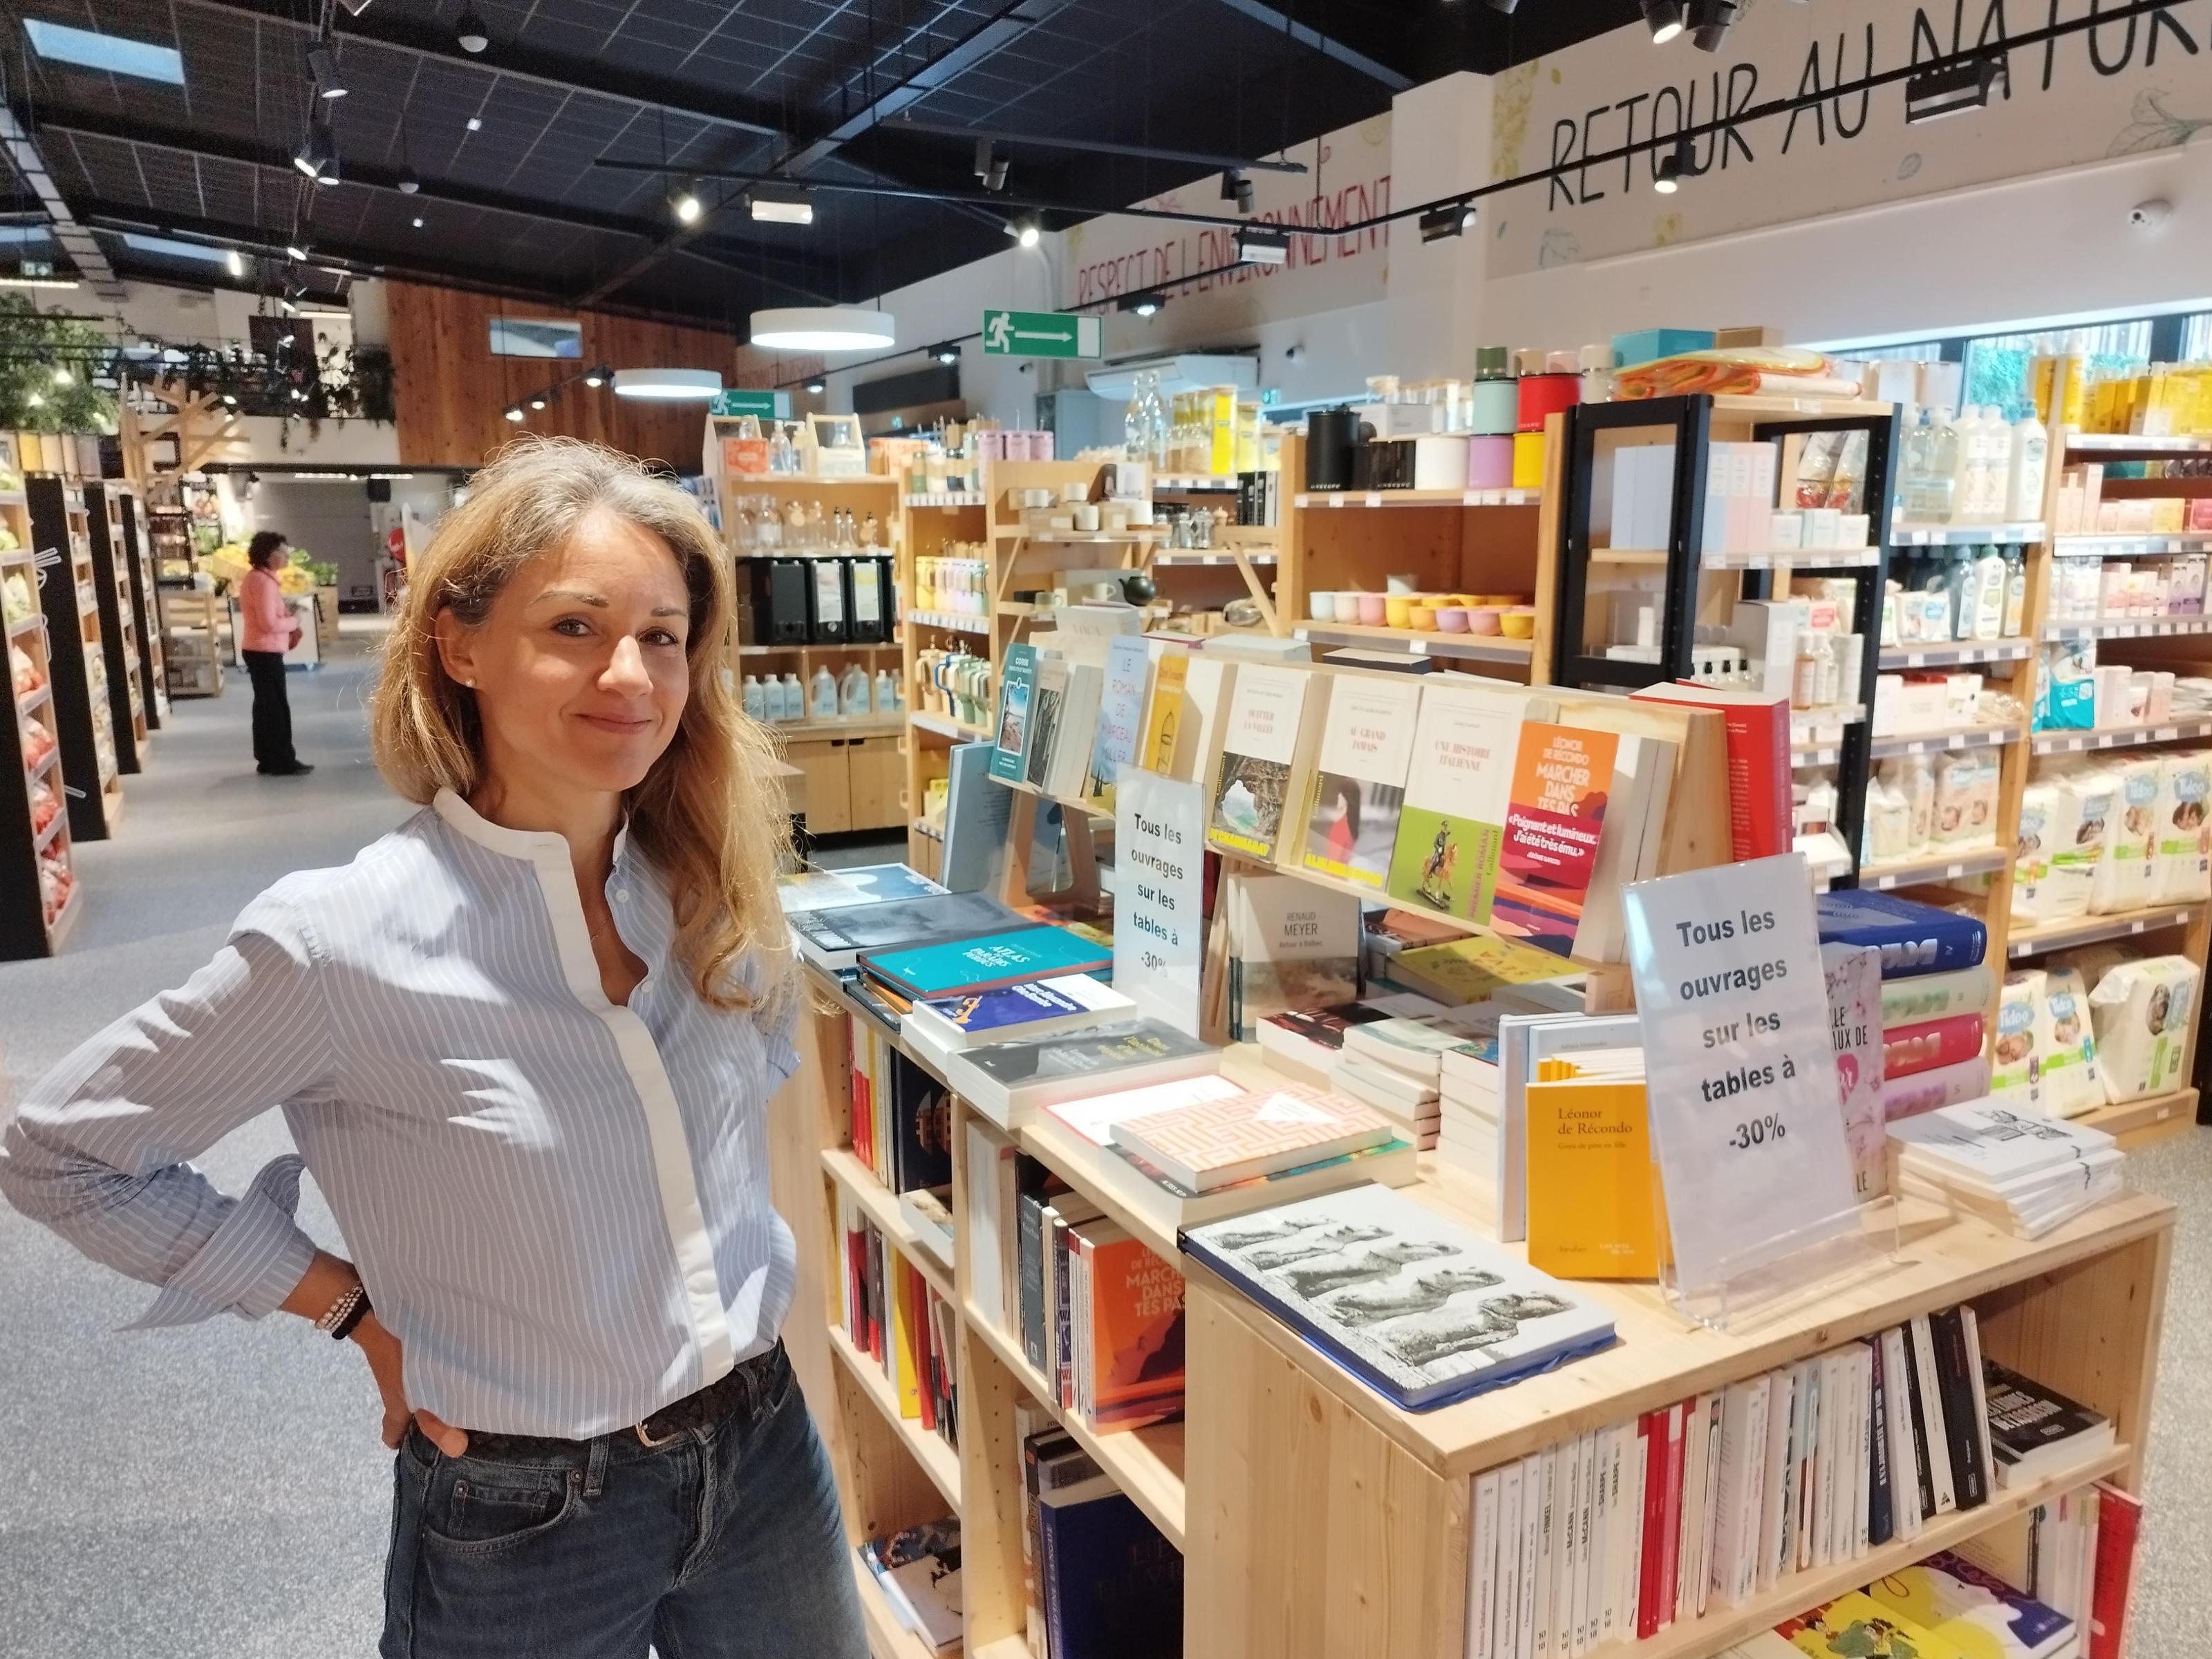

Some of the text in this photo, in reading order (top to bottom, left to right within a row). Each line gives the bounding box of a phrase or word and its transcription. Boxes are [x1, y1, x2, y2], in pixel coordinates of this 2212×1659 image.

[1548, 0, 2212, 211] RETOUR AU NATU
[1078, 250, 1147, 315] RESPECT
[1154, 241, 1174, 301] DE
[1123, 658, 1132, 672] LE
[1112, 679, 1136, 695] ROMAN
[1116, 702, 1126, 718] DE
[1248, 708, 1274, 722] QUITTER
[1360, 727, 1386, 741] GRAND
[1351, 740, 1378, 753] JAMAIS
[1435, 740, 1491, 759] UNE HISTOIRE
[1553, 736, 1583, 752] LÉONOR
[1438, 756, 1481, 772] ITALIENNE
[1553, 749, 1589, 766] RÉCONDO
[1536, 762, 1590, 787] MARCHER
[1545, 781, 1576, 803] DANS
[1537, 797, 1555, 814] TES
[1134, 813, 1181, 845] Tous les
[1547, 822, 1557, 835] et
[1528, 834, 1541, 847] été
[1541, 836, 1557, 852] très
[1487, 830, 1499, 876] Gallimard
[1131, 849, 1183, 880] ouvrages
[1468, 828, 1490, 919] PREMIER ROMAN
[1137, 883, 1175, 910] sur les
[1287, 912, 1316, 921] RENAUD
[1133, 911, 1179, 946] tables à
[1284, 923, 1318, 936] MEYER
[1676, 910, 1776, 947] Tous les
[989, 946, 1031, 963] ATLAS
[1140, 953, 1168, 978] -30%
[1680, 958, 1788, 1000] ouvrages
[1832, 1006, 1846, 1028] LE
[1998, 1006, 2029, 1024] Tidoo
[1703, 1011, 1781, 1048] sur les
[1856, 1025, 1868, 1046] DE
[1701, 1054, 1796, 1103] tables à
[1558, 1108, 1603, 1120] Léonor
[1558, 1121, 1633, 1135] de Récondo
[1730, 1112, 1785, 1150] -30%
[1125, 1268, 1181, 1289] MARC
[1143, 1280, 1183, 1299] DANS
[1135, 1300, 1160, 1317] TES
[1598, 1471, 1606, 1506] SHARPE
[1605, 1608, 1612, 1618] 10
[1577, 1625, 1584, 1635] 10
[1591, 1618, 1598, 1628] 10
[1539, 1630, 1546, 1640] 10
[1562, 1630, 1569, 1640] 10
